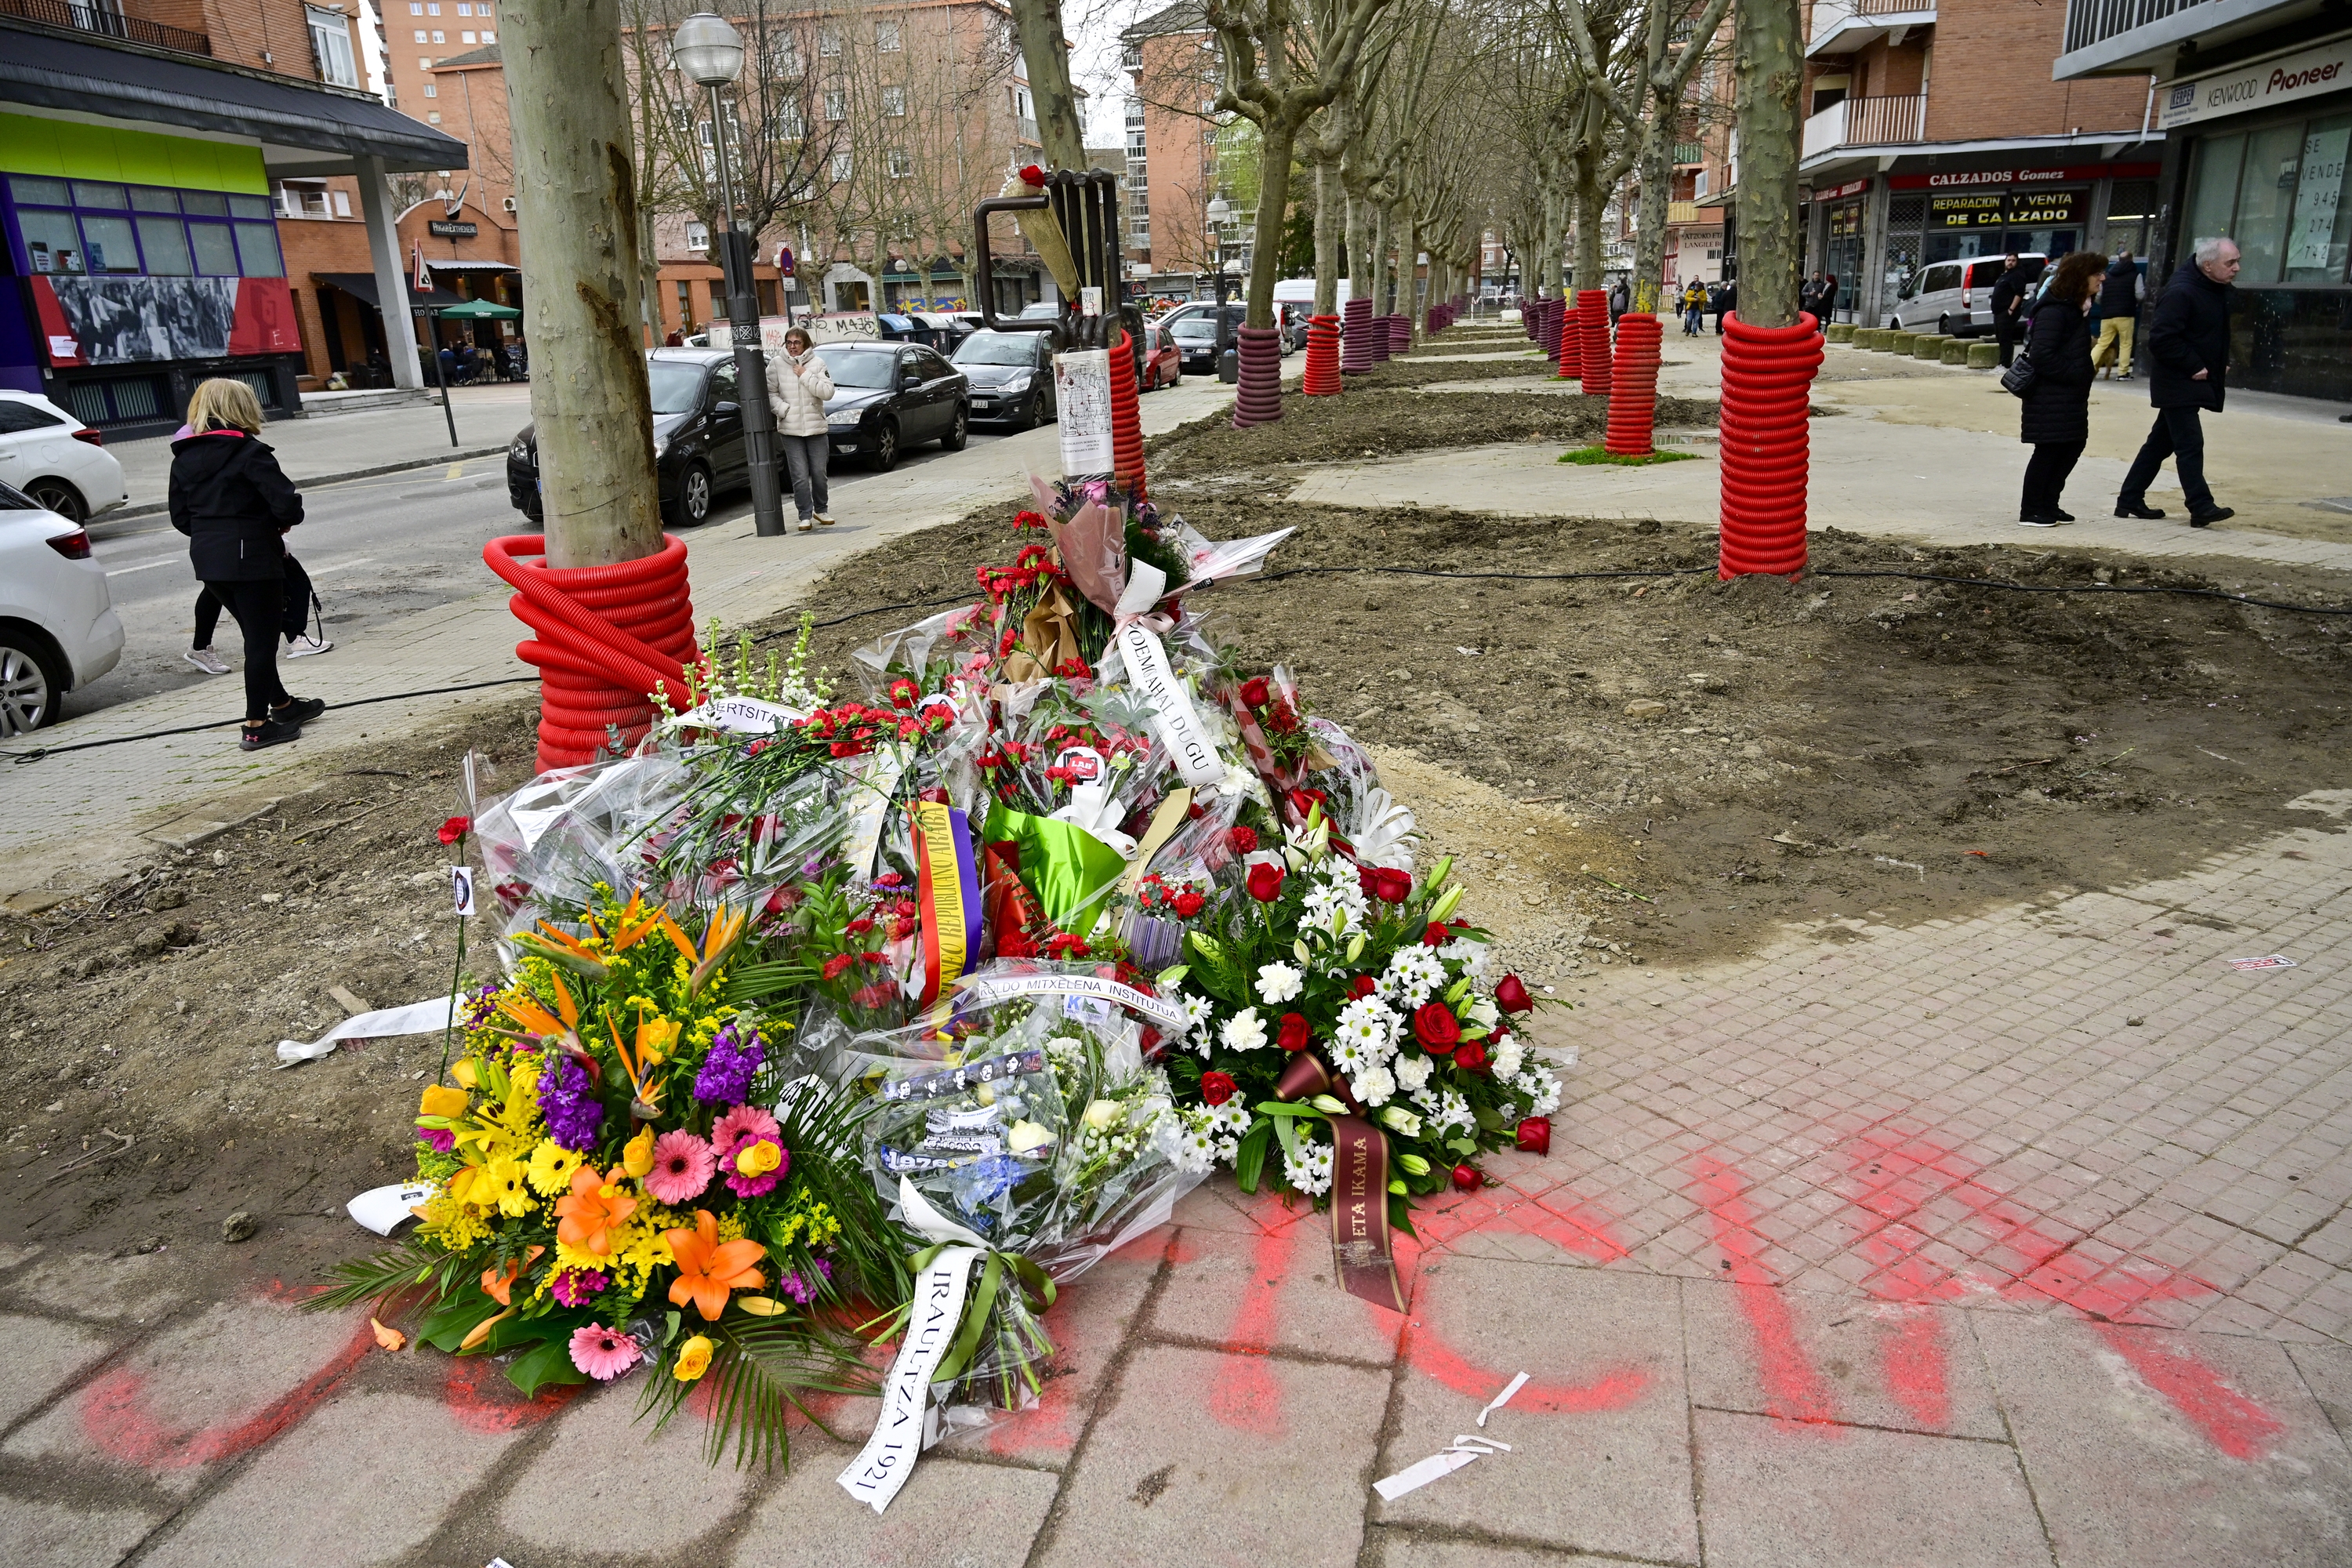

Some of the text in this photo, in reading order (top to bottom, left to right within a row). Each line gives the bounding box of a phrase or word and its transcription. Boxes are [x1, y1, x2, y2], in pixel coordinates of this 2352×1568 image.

[2266, 61, 2343, 94] Pioneer
[2171, 86, 2194, 107] KERPEN
[2207, 78, 2258, 108] KENWOOD
[2305, 139, 2321, 154] SE
[1929, 169, 2064, 186] CALZADOS Gomez
[2301, 162, 2343, 180] VENDE
[1933, 194, 2072, 210] REPARACION Y VENTA
[2314, 191, 2338, 207] 945
[1947, 214, 1969, 225] DE
[2310, 219, 2332, 233] 274
[2305, 245, 2328, 260] 742
[1145, 676, 1175, 717] AHAL
[1169, 715, 1210, 771] DUGU
[1072, 760, 1093, 770] LAB
[923, 807, 965, 996] TENEO REPUBLICANO ARABA
[980, 979, 1178, 1019] KOLDO MITXELENA INSTITUTUA
[888, 1150, 947, 1171] 1976
[1352, 1136, 1367, 1196] IKAMA
[1352, 1200, 1366, 1236] ETA
[855, 1269, 952, 1490] IRAULTZA 1921
